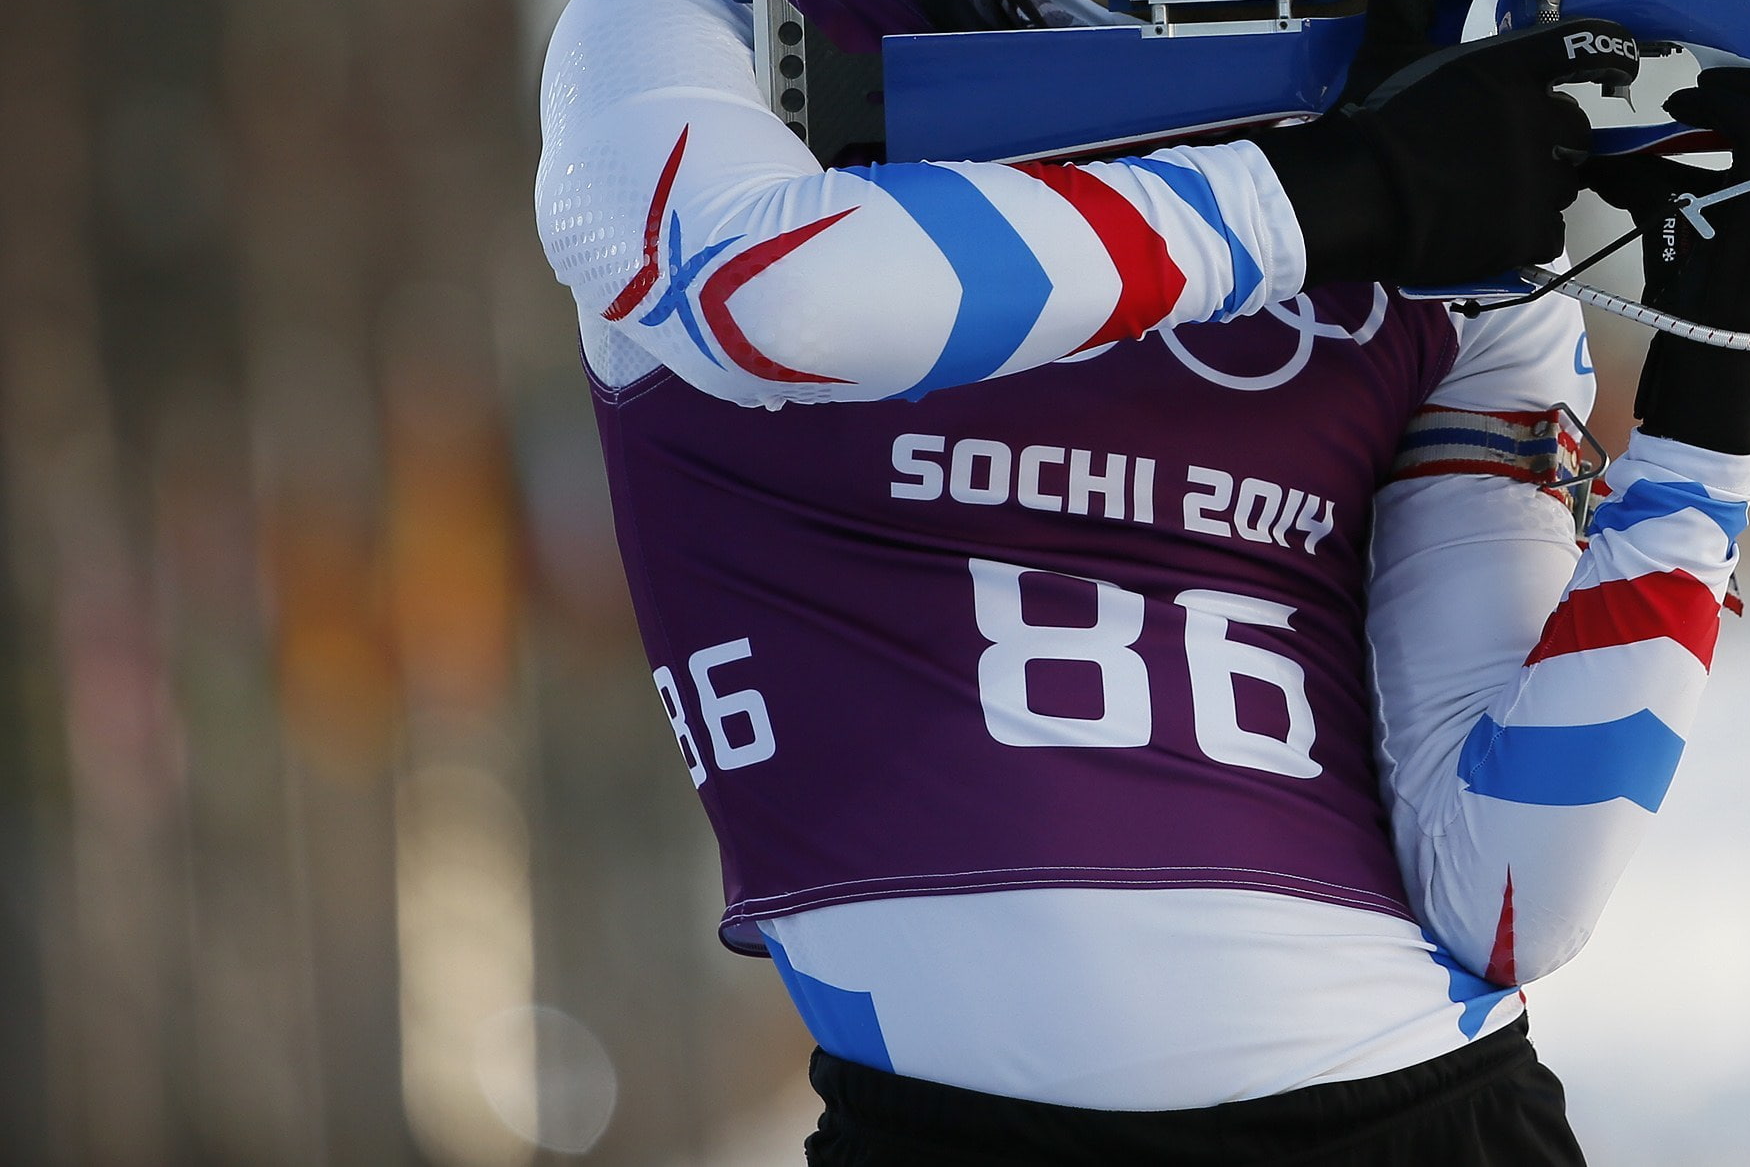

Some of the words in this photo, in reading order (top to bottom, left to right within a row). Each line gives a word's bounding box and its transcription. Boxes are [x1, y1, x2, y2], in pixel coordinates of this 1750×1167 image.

[1662, 214, 1676, 246] RIP
[890, 433, 1156, 524] SOCHI
[1183, 464, 1335, 556] 2014
[652, 637, 776, 790] 86
[968, 557, 1323, 779] 86
